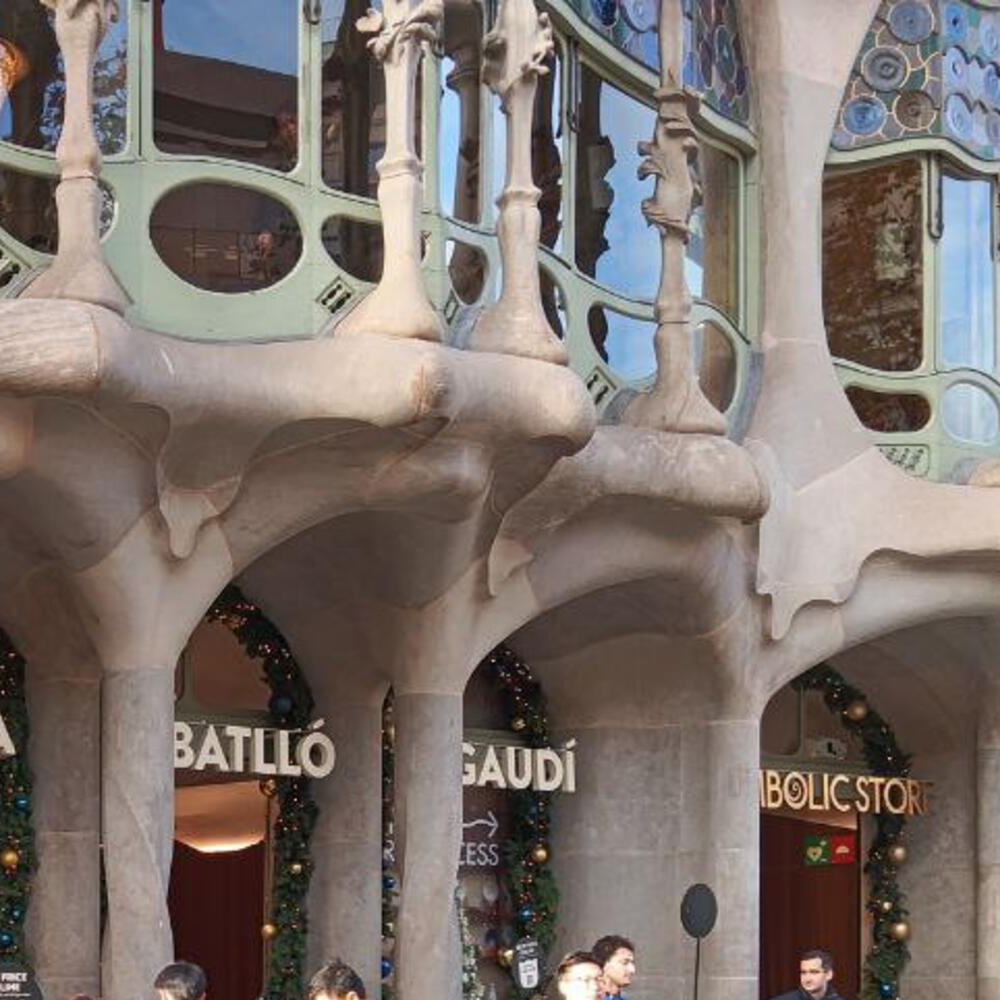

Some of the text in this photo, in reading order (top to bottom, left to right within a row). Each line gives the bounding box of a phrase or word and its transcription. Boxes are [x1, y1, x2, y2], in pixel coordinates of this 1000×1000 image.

[174, 718, 336, 778] BATLLÓ
[461, 738, 576, 792] GAUDÍ
[759, 769, 850, 812] BOLIC
[1, 972, 28, 982] PRICE
